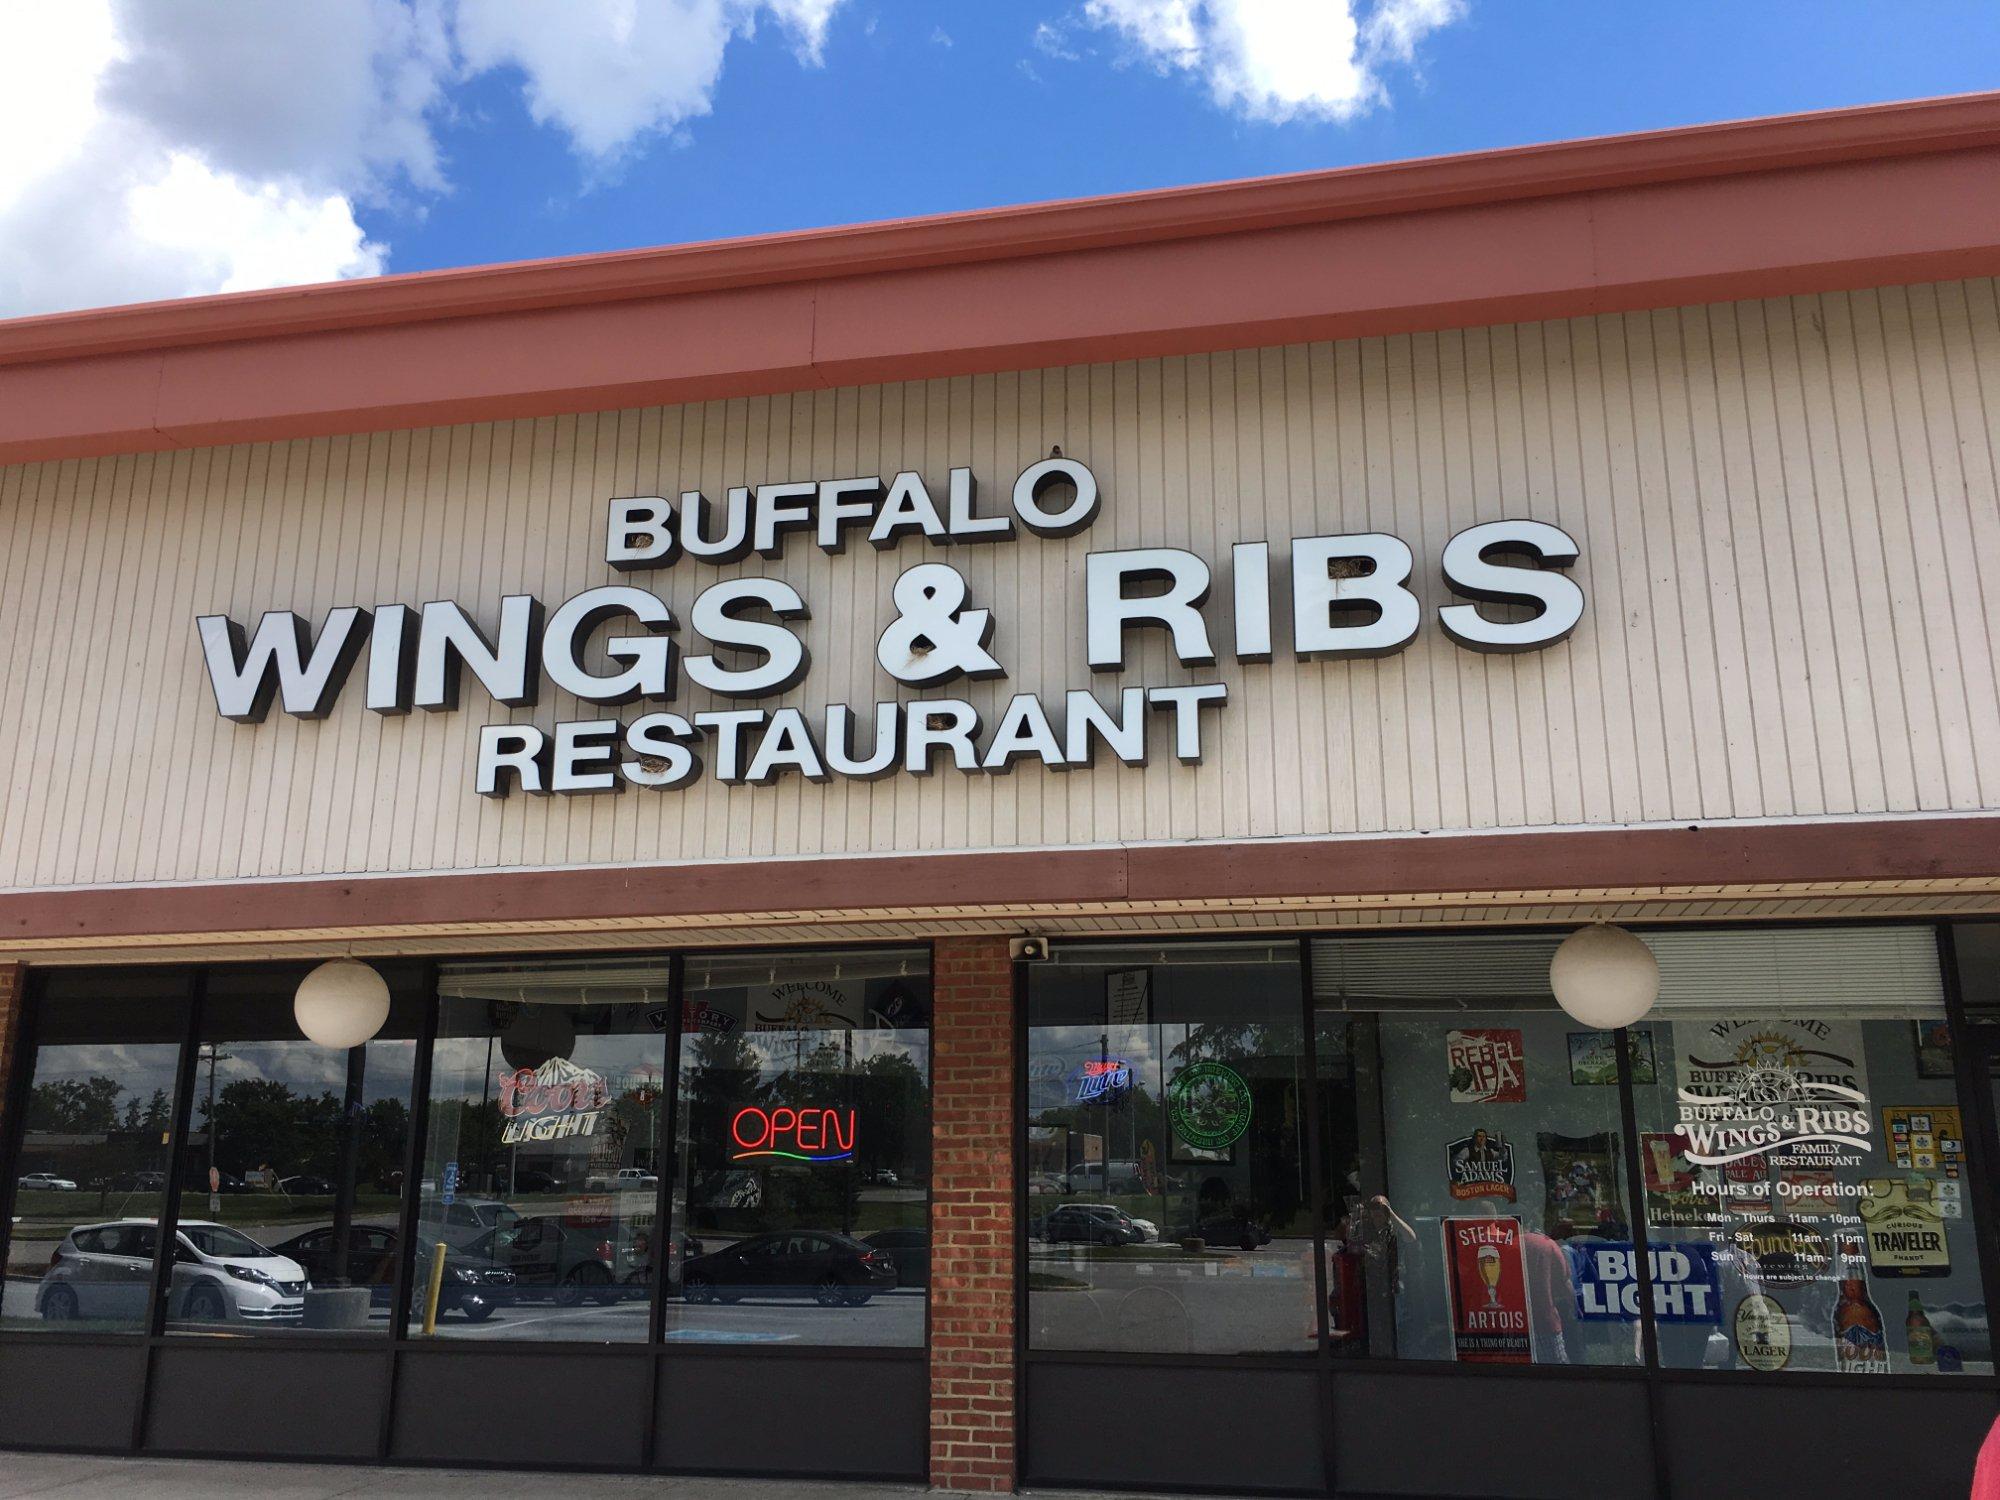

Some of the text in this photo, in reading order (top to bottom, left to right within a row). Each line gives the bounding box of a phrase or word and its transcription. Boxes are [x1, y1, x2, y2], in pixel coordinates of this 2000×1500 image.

[605, 457, 1099, 569] BUFFALO
[196, 519, 1585, 721] WINGS & RIBS
[475, 684, 1228, 796] RESTAURANT
[772, 981, 847, 1007] WELCOME
[656, 1008, 730, 1025] VTORY
[1451, 1041, 1523, 1068] REBEL
[1472, 1059, 1519, 1092] IPA
[1679, 1106, 1775, 1122] BUFFALO
[501, 1111, 604, 1144] LIGHT
[731, 1106, 857, 1150] OPEN
[1673, 1107, 1871, 1154] WINGS & RIBS
[1792, 1144, 1841, 1154] FAMILY
[1455, 1159, 1508, 1173] SAMUEL
[1769, 1155, 1863, 1166] RESTAURANT
[1458, 1171, 1505, 1184] ADAMS
[1456, 1184, 1510, 1197] BOSTON LAGER
[1692, 1181, 1874, 1198] Hours of Operation:
[1650, 1207, 1708, 1222] Heinek
[1707, 1213, 1731, 1223] Mon
[1742, 1212, 1776, 1223] Thurs
[1789, 1213, 1819, 1223] 11am
[1830, 1213, 1861, 1226] 10pm
[1458, 1225, 1514, 1246] STELLA
[1709, 1232, 1725, 1242] Fri
[1734, 1232, 1755, 1242] Sat
[1792, 1233, 1822, 1243] 11am
[1833, 1233, 1864, 1246] 11pm
[1872, 1231, 1942, 1252] TRAVELER
[1596, 1251, 1690, 1282] BUD
[1711, 1252, 1734, 1262] Sun
[1794, 1253, 1824, 1263] 11am
[1840, 1253, 1866, 1266] 9pm
[1780, 1273, 1805, 1282] subject
[1582, 1283, 1711, 1316] LIGHT
[1468, 1311, 1524, 1329] ARTOIS
[1744, 1345, 1787, 1357] LAGER
